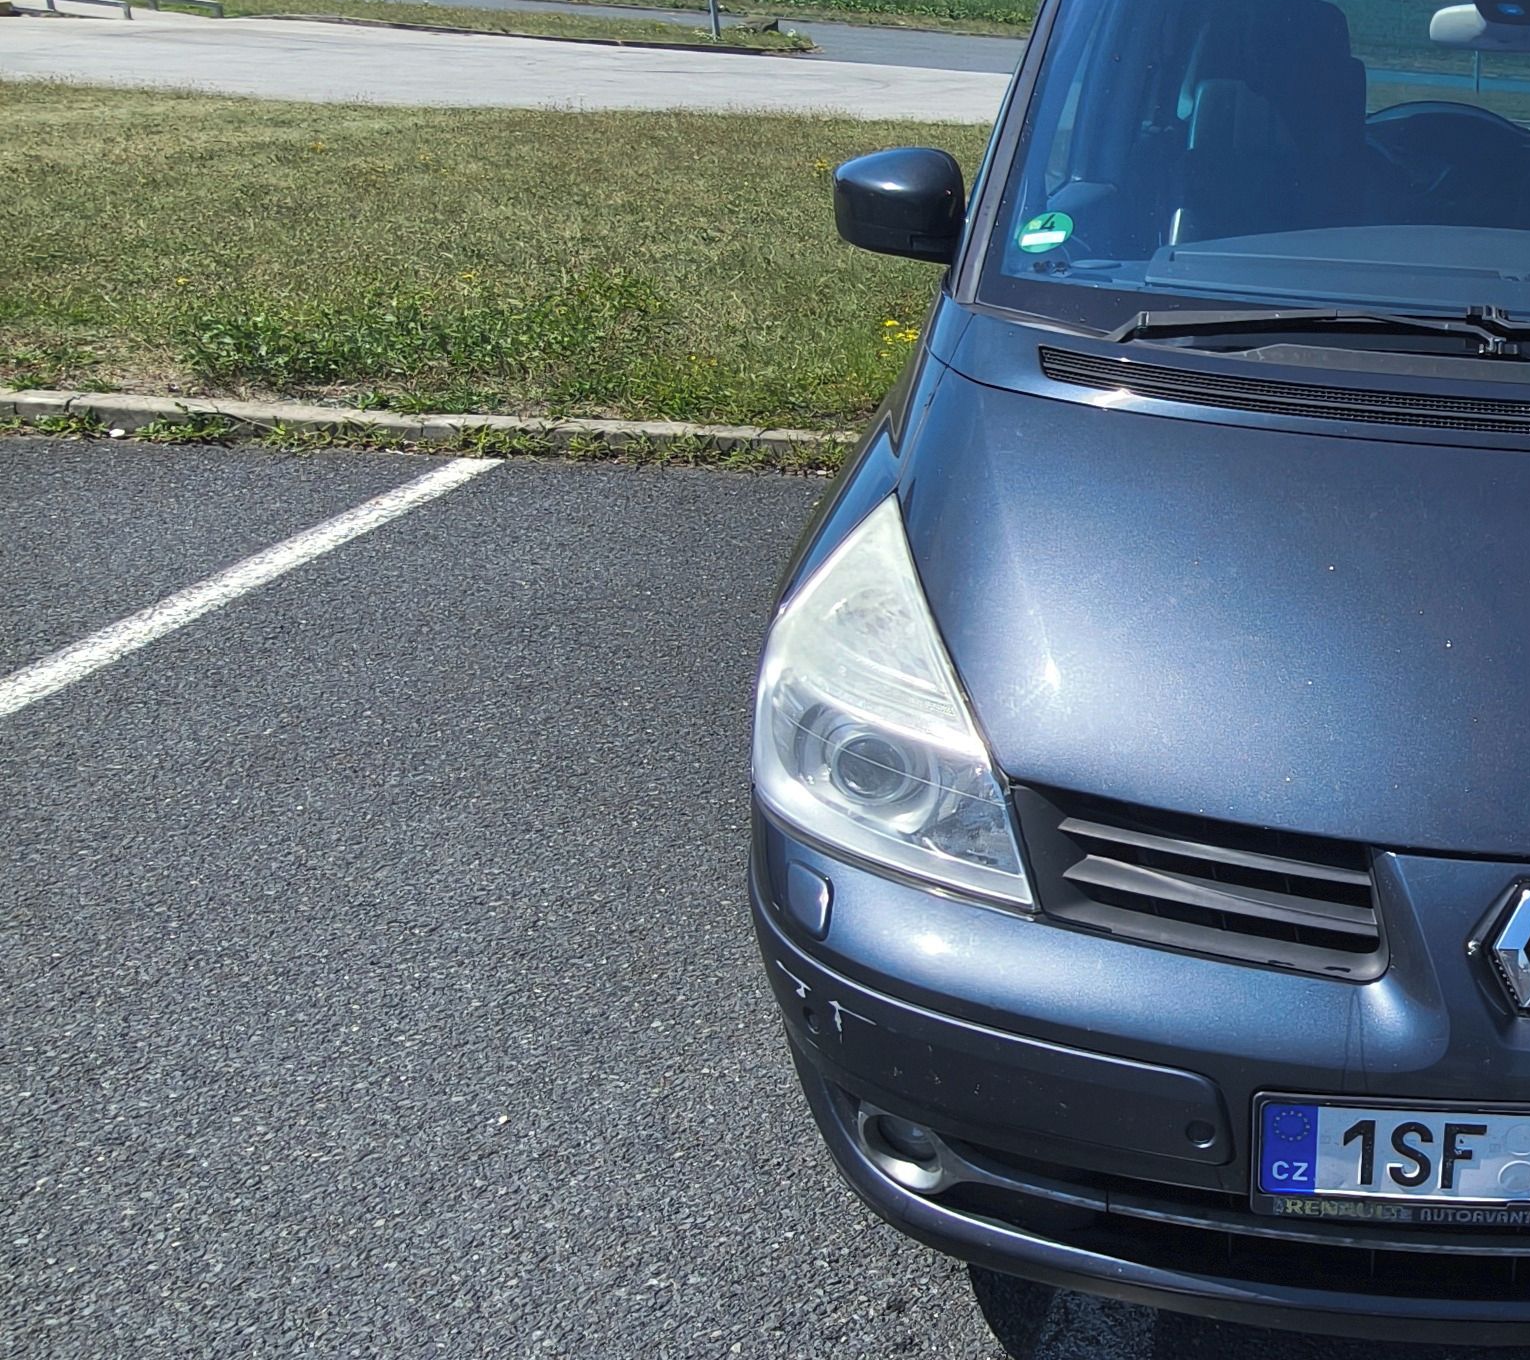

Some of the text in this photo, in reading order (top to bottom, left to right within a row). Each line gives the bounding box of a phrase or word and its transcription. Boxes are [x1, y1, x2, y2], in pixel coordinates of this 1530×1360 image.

[1040, 213, 1056, 231] 4
[1342, 1119, 1487, 1189] 1SF
[1272, 1160, 1308, 1181] CZ
